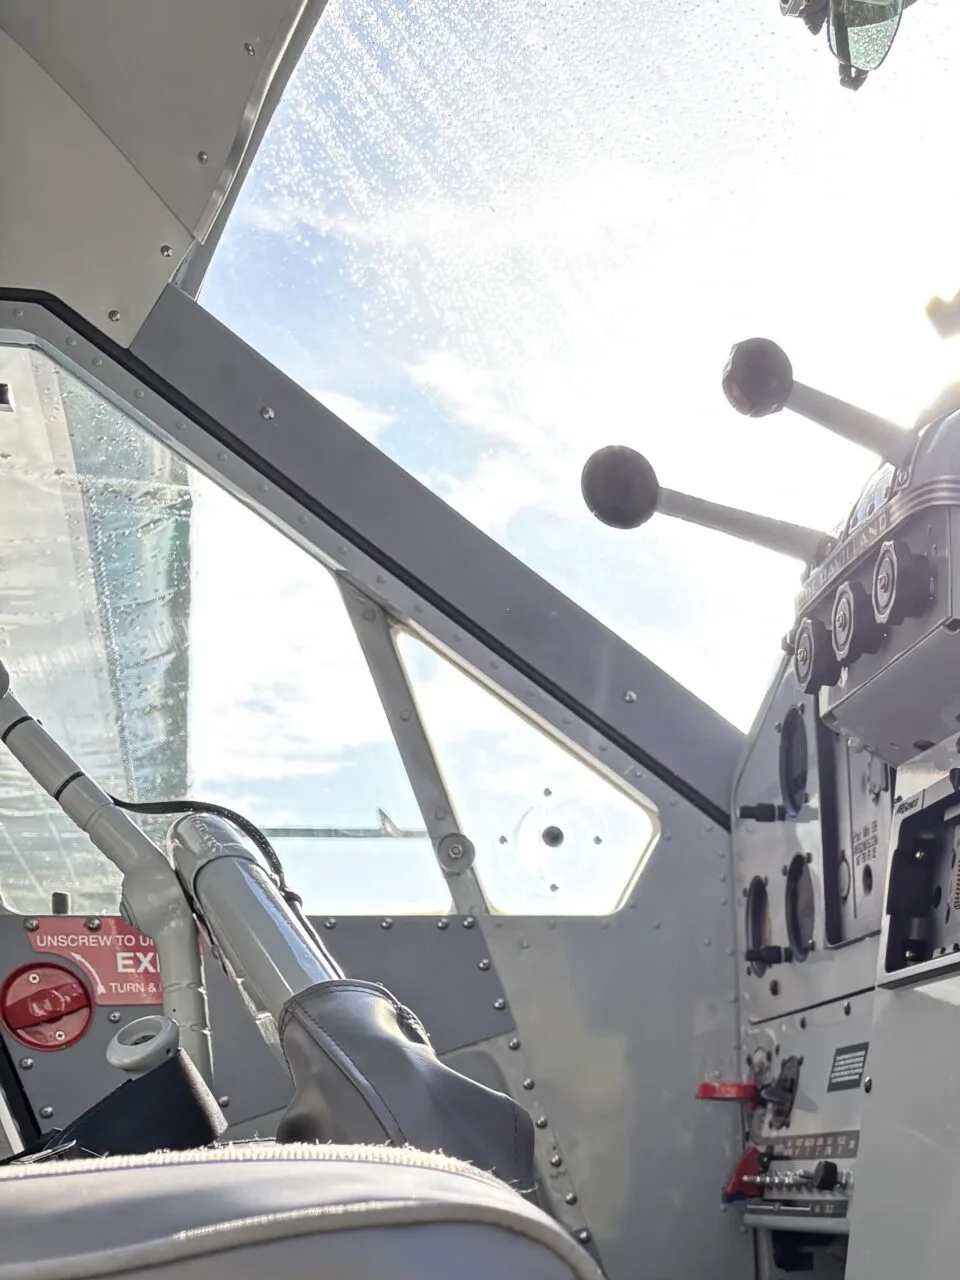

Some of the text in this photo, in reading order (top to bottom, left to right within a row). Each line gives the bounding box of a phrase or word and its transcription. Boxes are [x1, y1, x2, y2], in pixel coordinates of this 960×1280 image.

[36, 935, 112, 947] UNSCREW
[116, 935, 135, 946] TO
[109, 982, 144, 993] TURN
